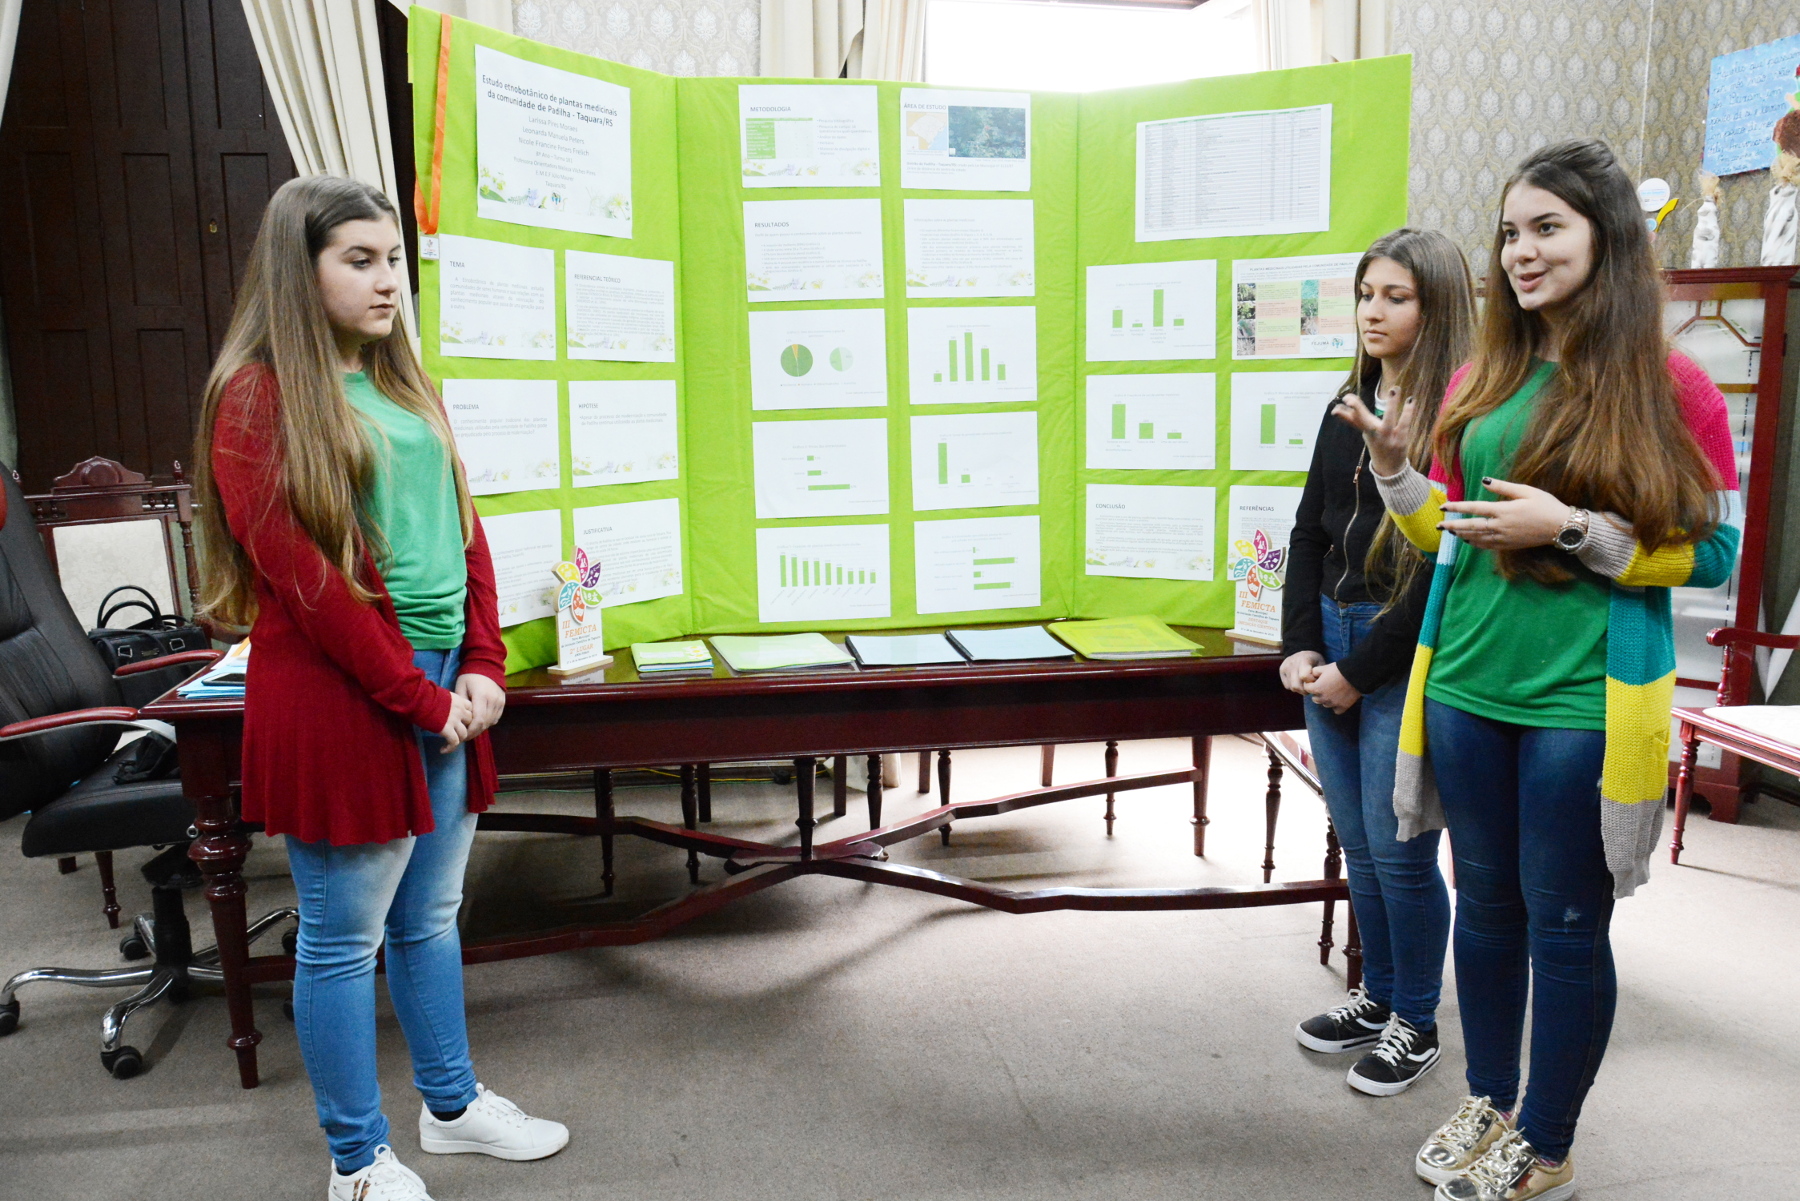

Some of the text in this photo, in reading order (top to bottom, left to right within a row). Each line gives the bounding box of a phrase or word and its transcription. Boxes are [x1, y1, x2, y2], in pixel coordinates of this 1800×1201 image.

[482, 74, 618, 117] Estudo etnobotânico de plantas medicinais
[487, 89, 496, 99] da
[496, 94, 535, 110] comunidade
[537, 102, 547, 112] de
[547, 105, 571, 118] Padilha
[576, 111, 614, 127] Taquara/RS
[903, 102, 918, 110] ÁREA
[449, 260, 466, 268] TEMA
[574, 273, 603, 282] REFERENCIAL
[1239, 590, 1249, 599] III
[1240, 599, 1277, 613] FEMICTA
[562, 619, 571, 630] III
[564, 623, 598, 639] FEMICTA
